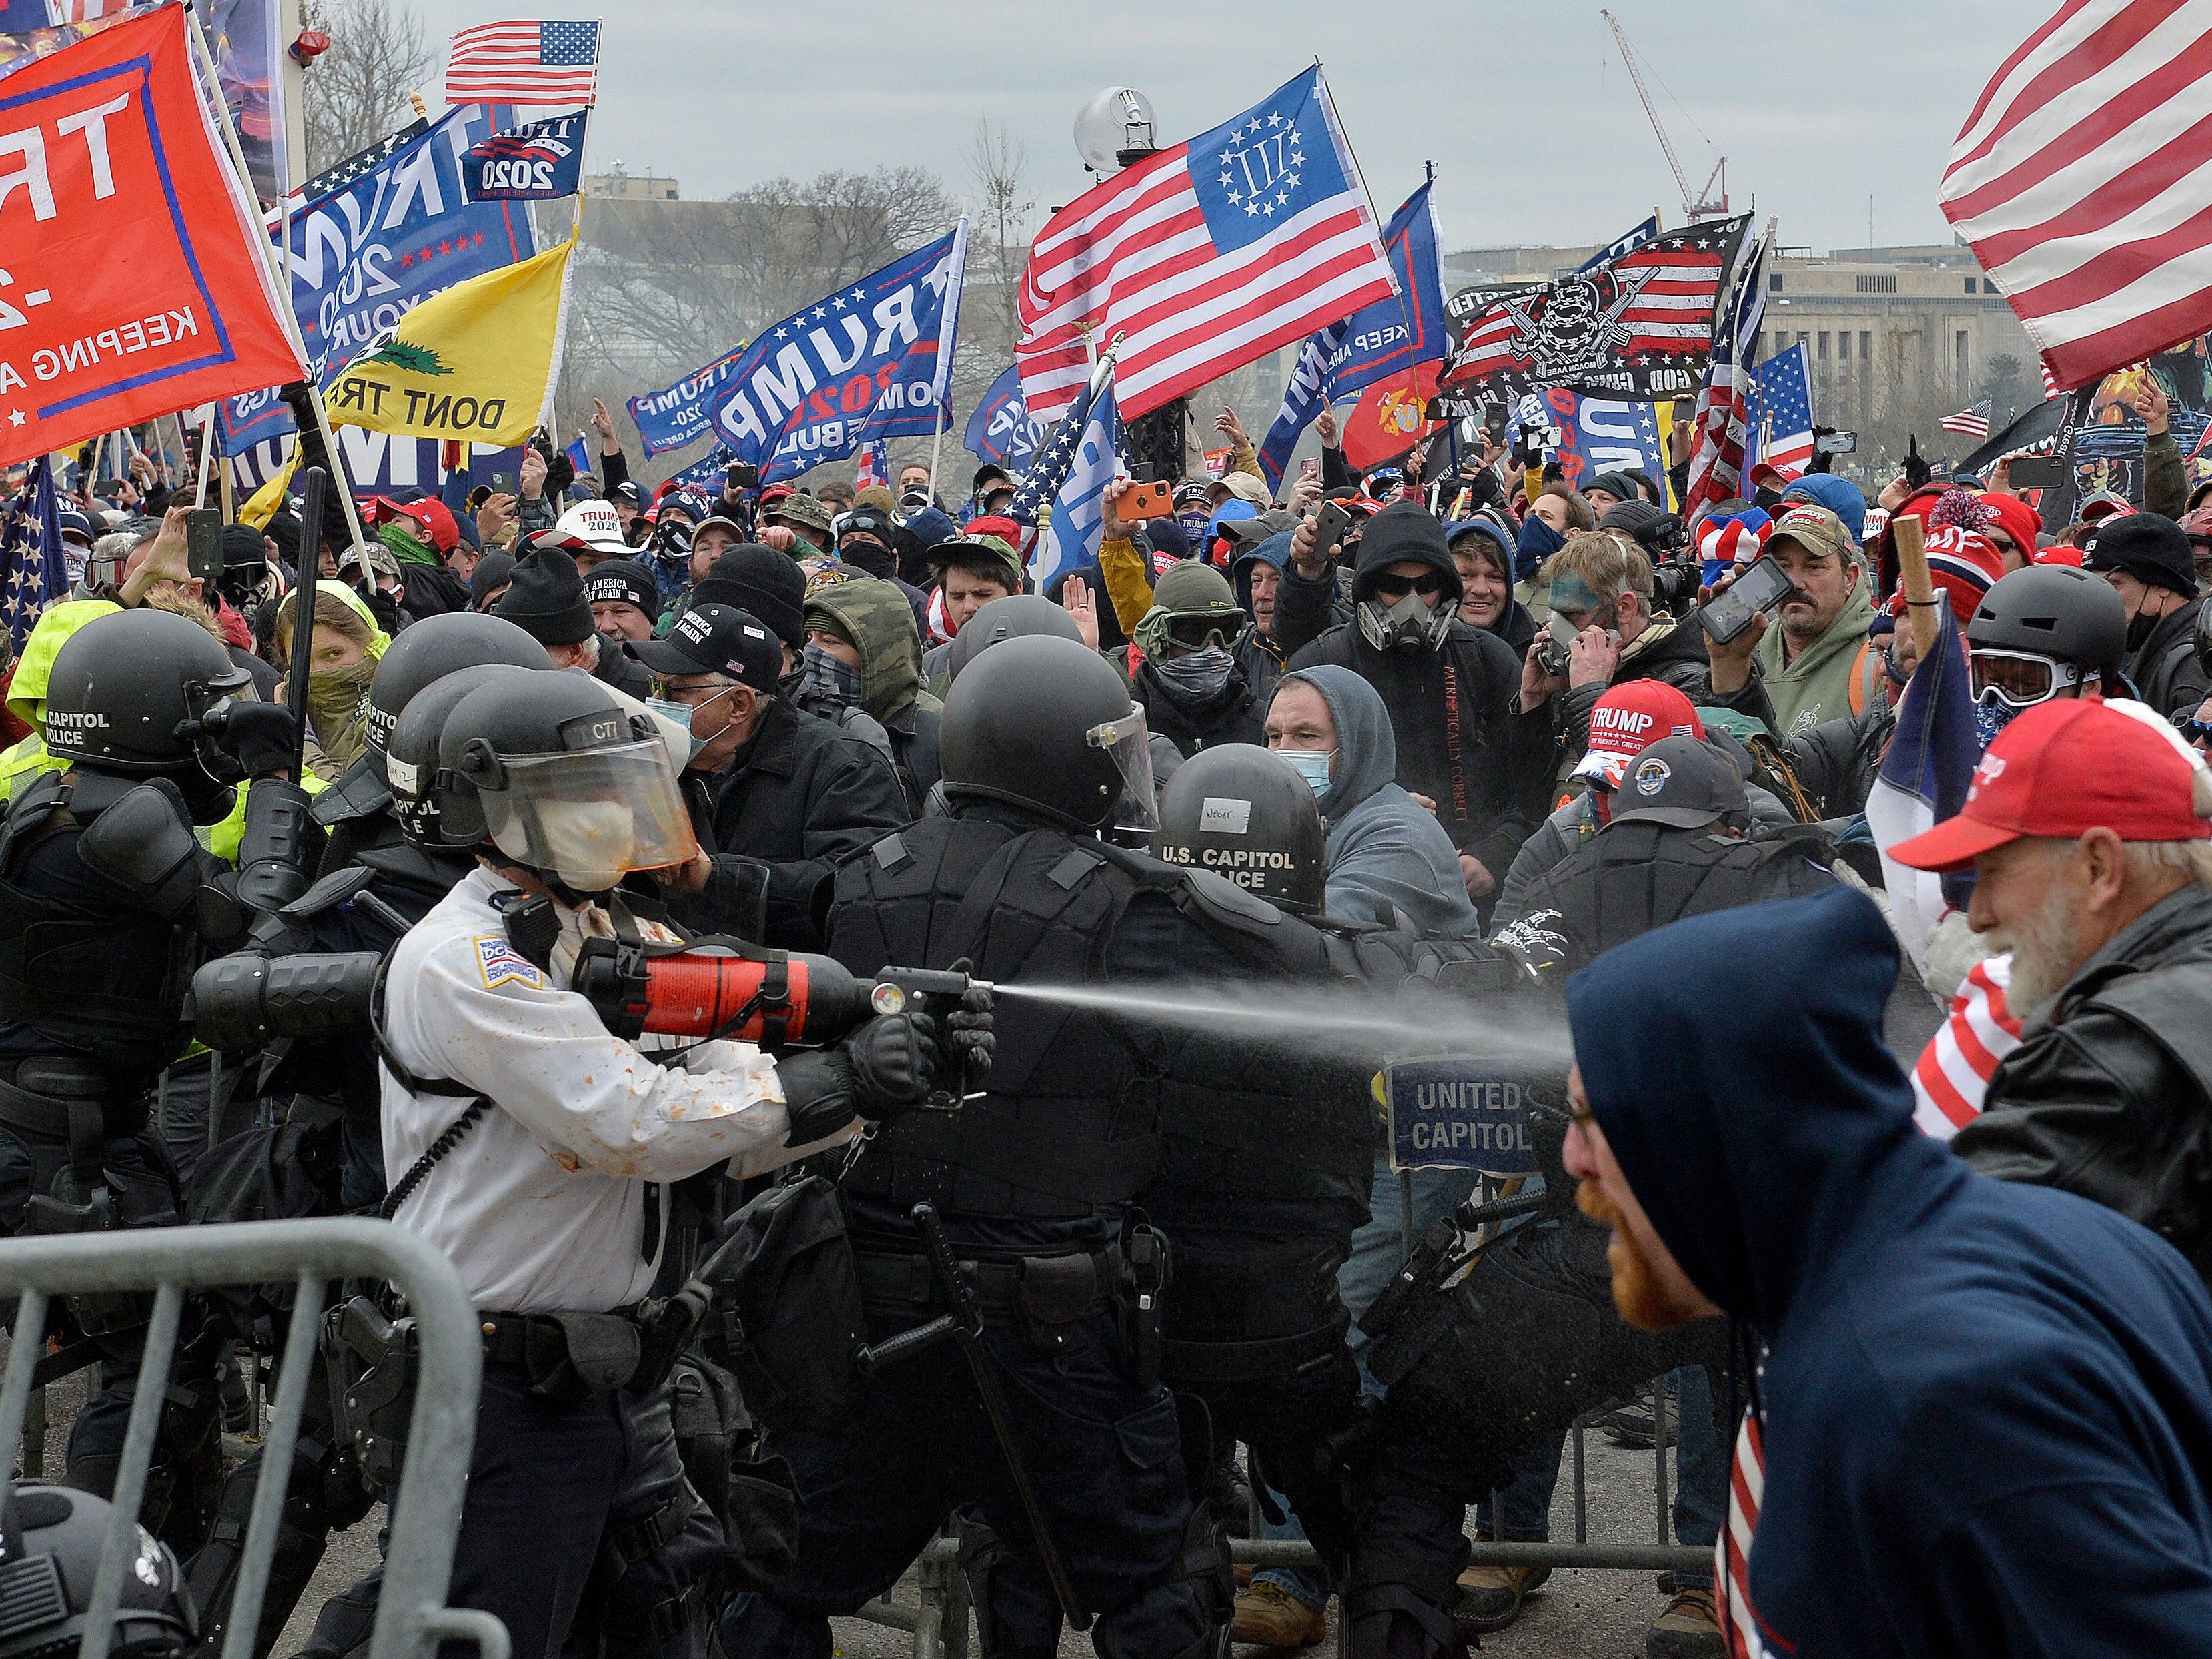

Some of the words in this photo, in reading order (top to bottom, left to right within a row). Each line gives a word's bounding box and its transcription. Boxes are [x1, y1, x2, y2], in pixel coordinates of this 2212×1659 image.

[588, 521, 617, 532] 2020
[592, 578, 628, 590] AMERICA
[598, 589, 621, 600] AGAIN
[48, 710, 110, 728] CAPITOL
[1592, 708, 1654, 734] TRUMP
[1162, 845, 1196, 864] U.S.
[1202, 849, 1295, 869] CAPITOL
[482, 946, 506, 960] DC
[1417, 1082, 1522, 1110] UNITED
[1412, 1121, 1532, 1151] CAPITOL
